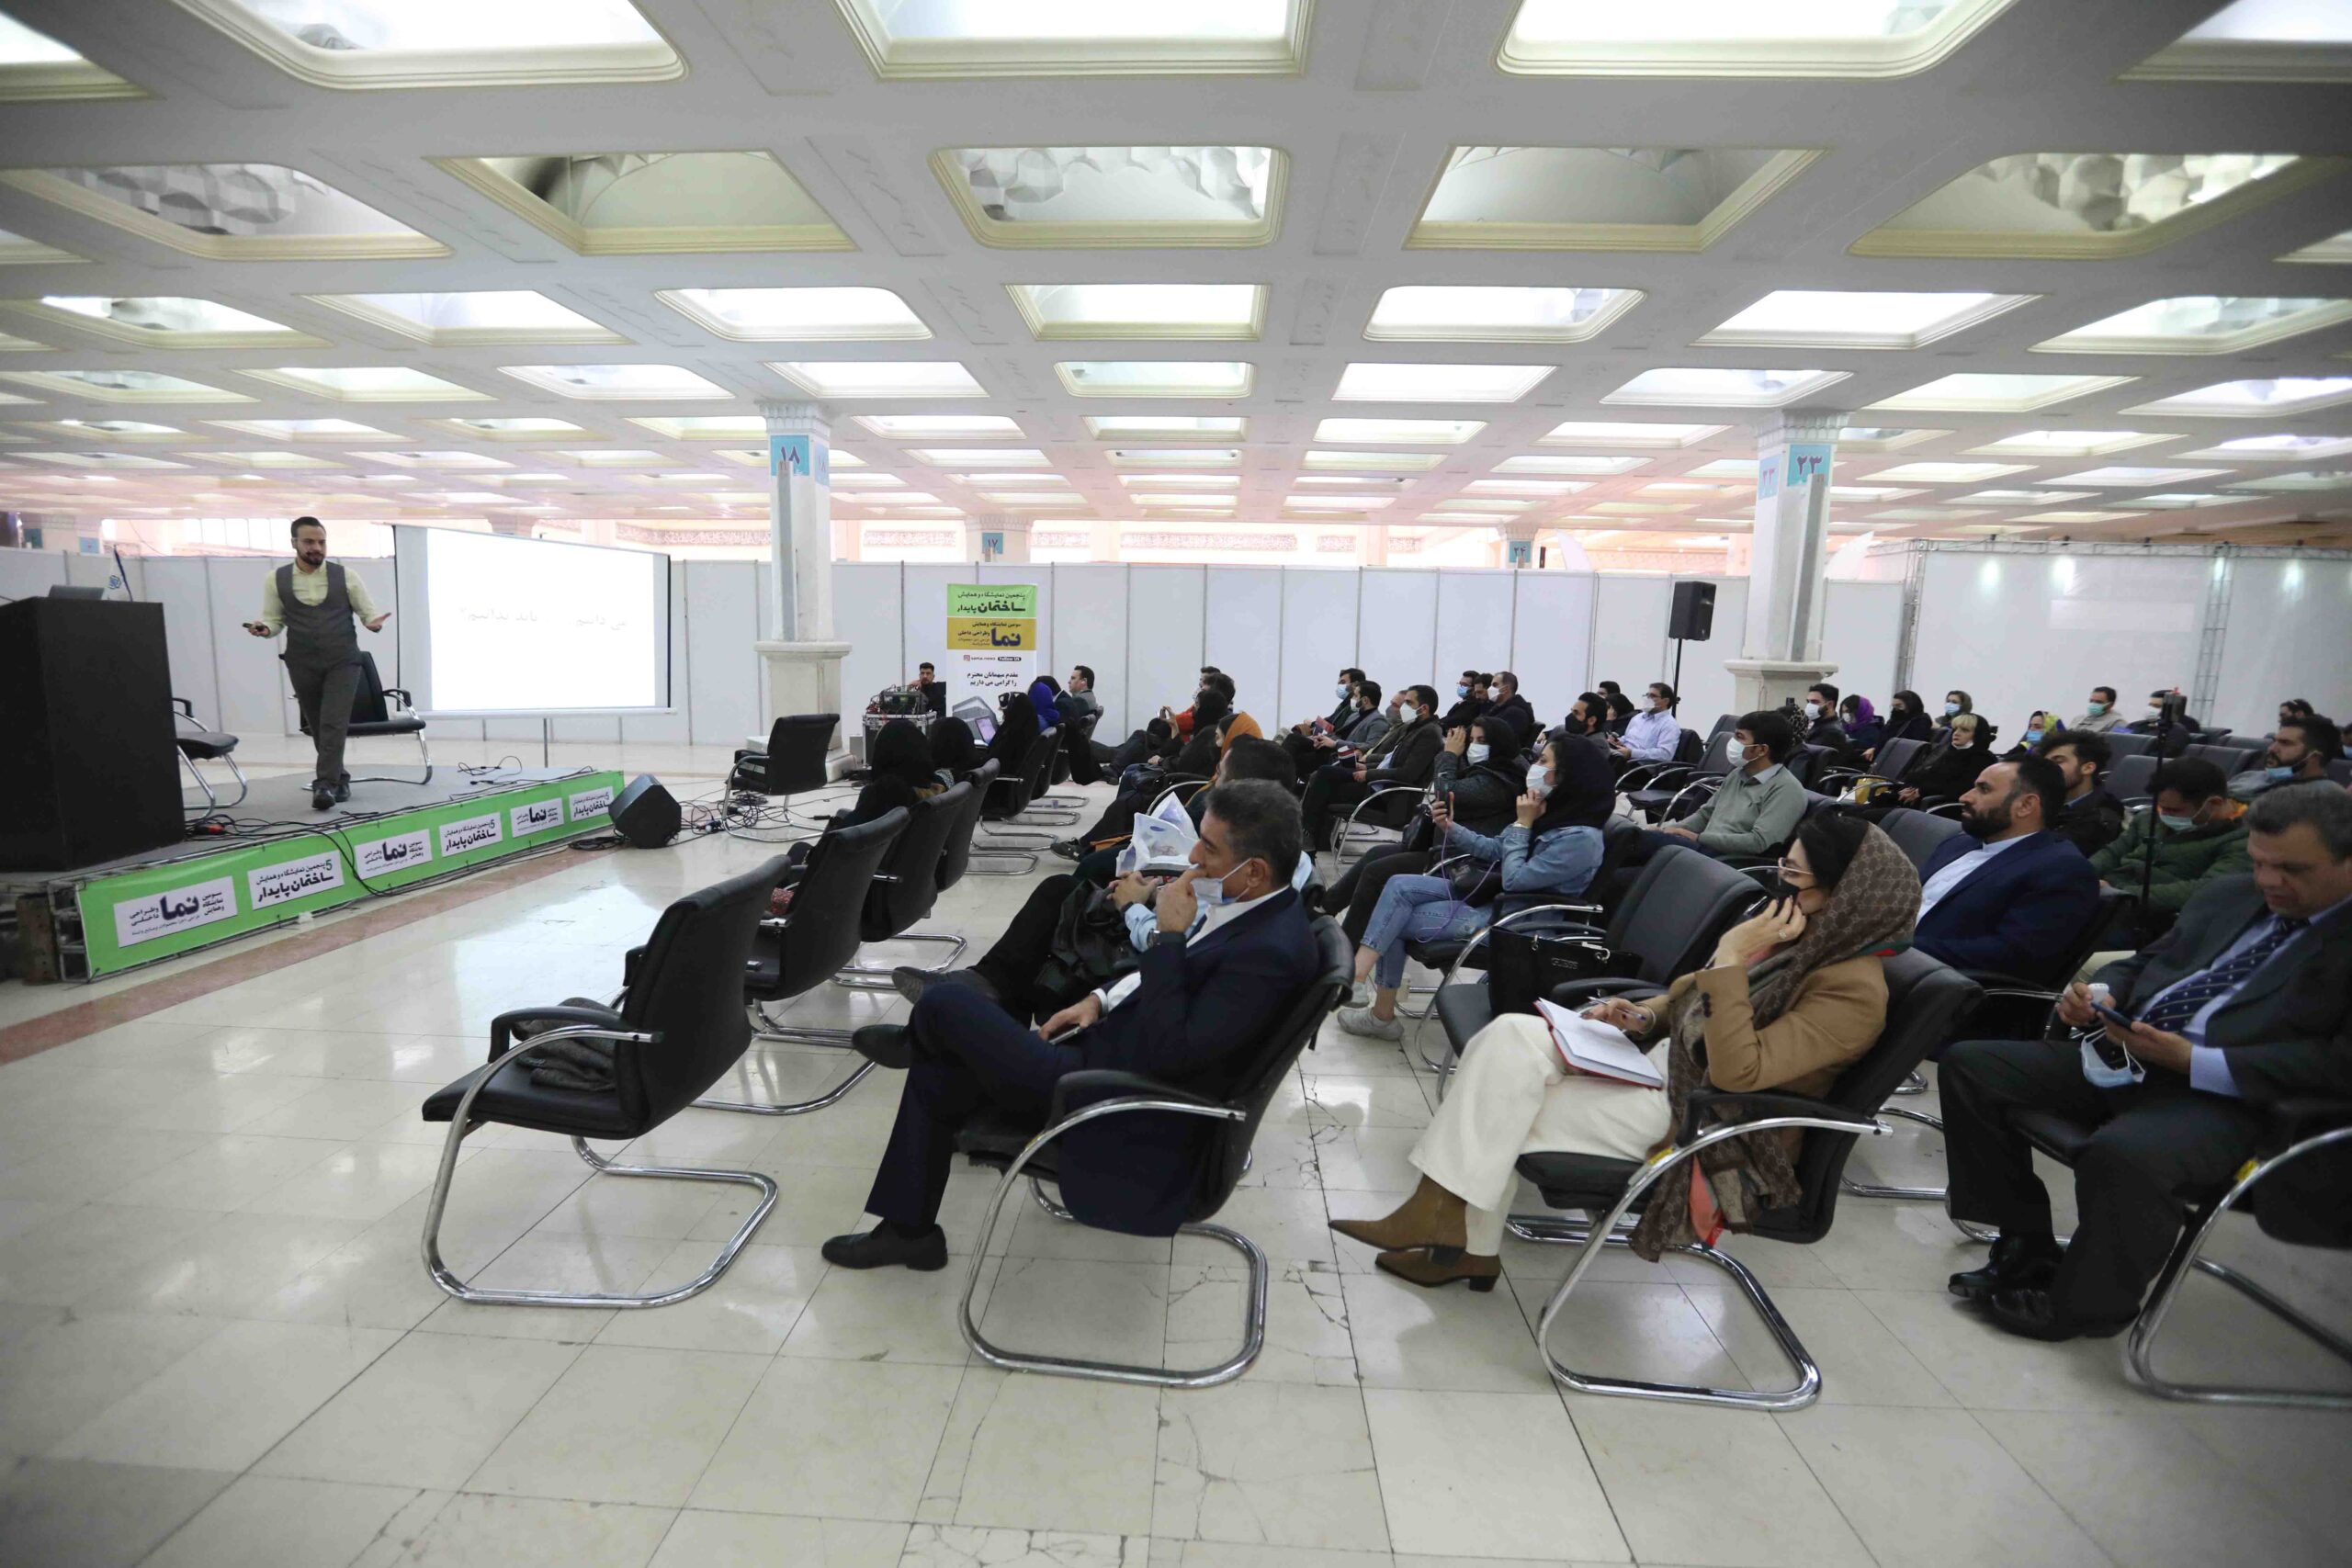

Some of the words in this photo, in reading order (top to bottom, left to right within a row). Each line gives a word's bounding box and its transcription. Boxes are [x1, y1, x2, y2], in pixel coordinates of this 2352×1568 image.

[1796, 456, 1823, 476] ۲۳
[956, 604, 977, 614] پایدار
[978, 600, 1026, 613] ساختمان
[990, 626, 1022, 647] نما
[529, 807, 547, 823] نما
[446, 836, 467, 852] پایدار
[467, 829, 496, 845] ساختمان
[382, 841, 407, 862] نما
[325, 859, 333, 871] 5
[290, 872, 334, 892] ساختمان
[202, 892, 222, 901] سومین
[258, 882, 290, 902] پایدار
[160, 895, 199, 921] نما
[202, 897, 223, 908] نمایشگاه
